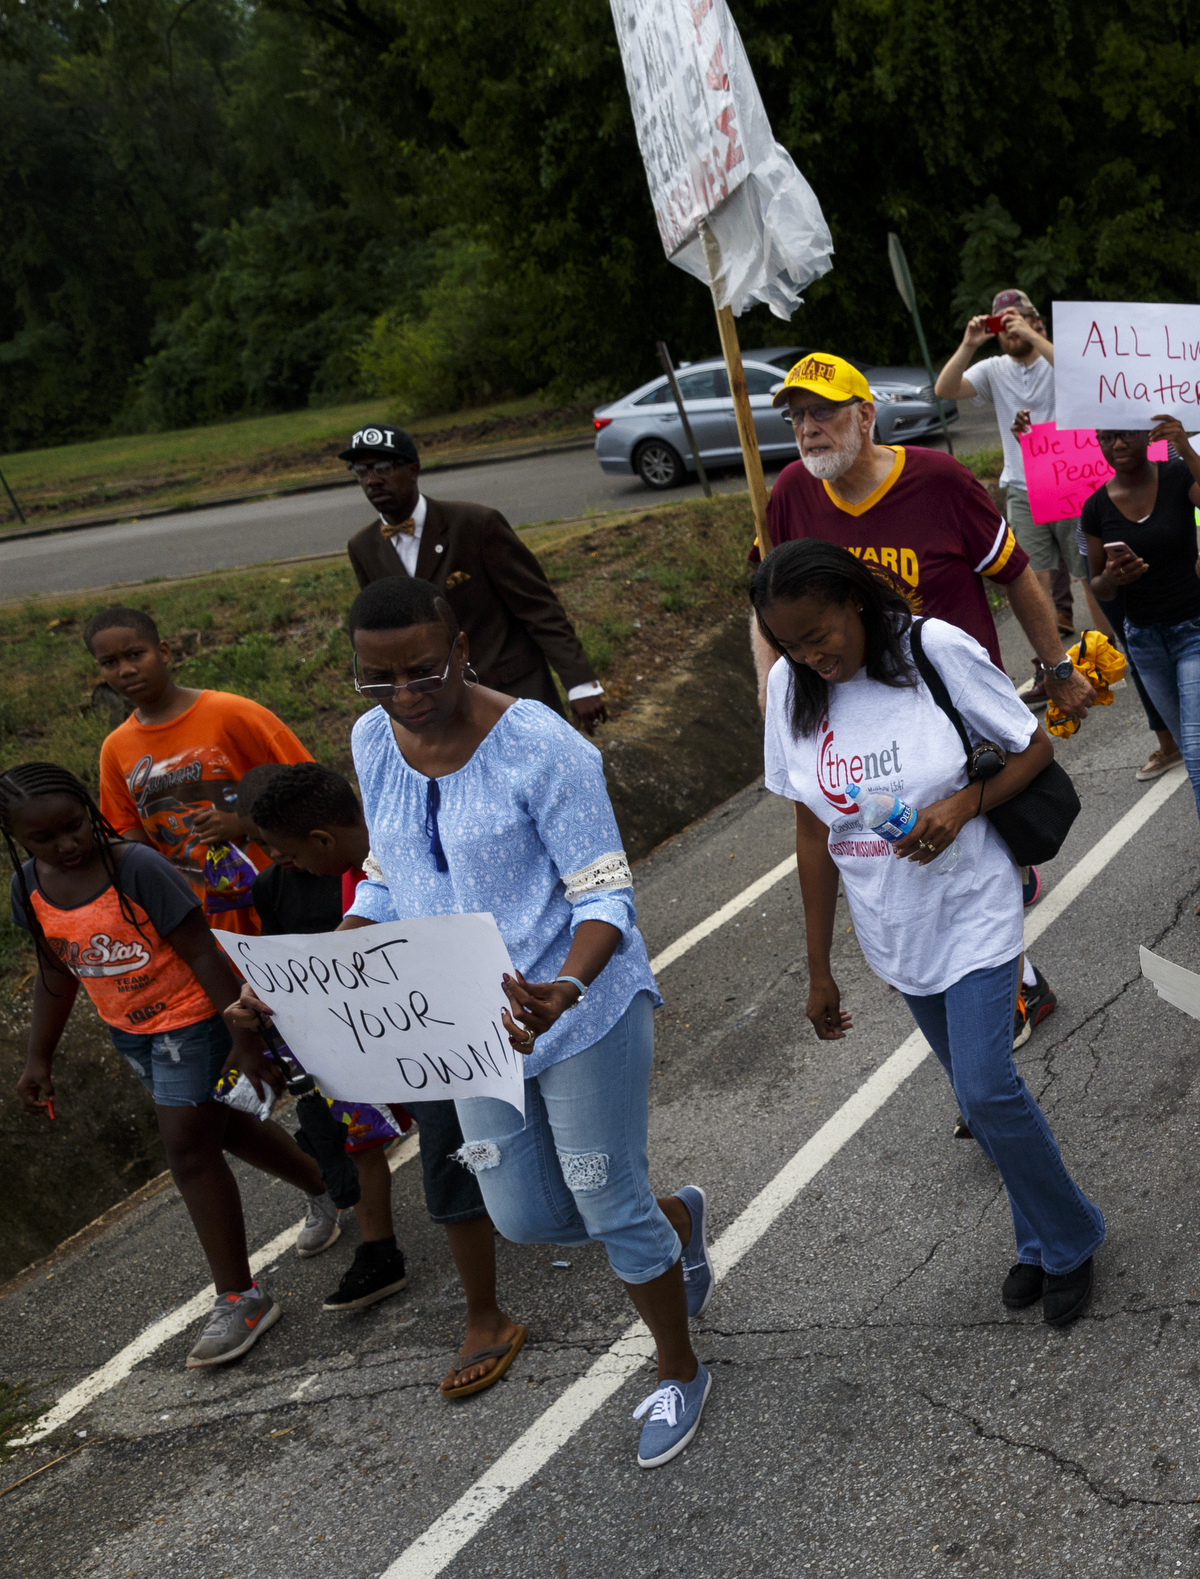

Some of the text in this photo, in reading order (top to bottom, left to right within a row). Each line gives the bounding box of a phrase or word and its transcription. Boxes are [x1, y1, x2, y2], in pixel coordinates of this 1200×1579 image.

[1082, 321, 1151, 358] ALL
[352, 428, 395, 448] FOI
[1029, 435, 1065, 457] We
[843, 546, 919, 588] WARD
[829, 841, 855, 857] ESTSIDE
[81, 933, 151, 966] Star
[114, 974, 150, 986] TEAM
[237, 938, 409, 995] SUPPORT
[327, 990, 455, 1053] YOUR
